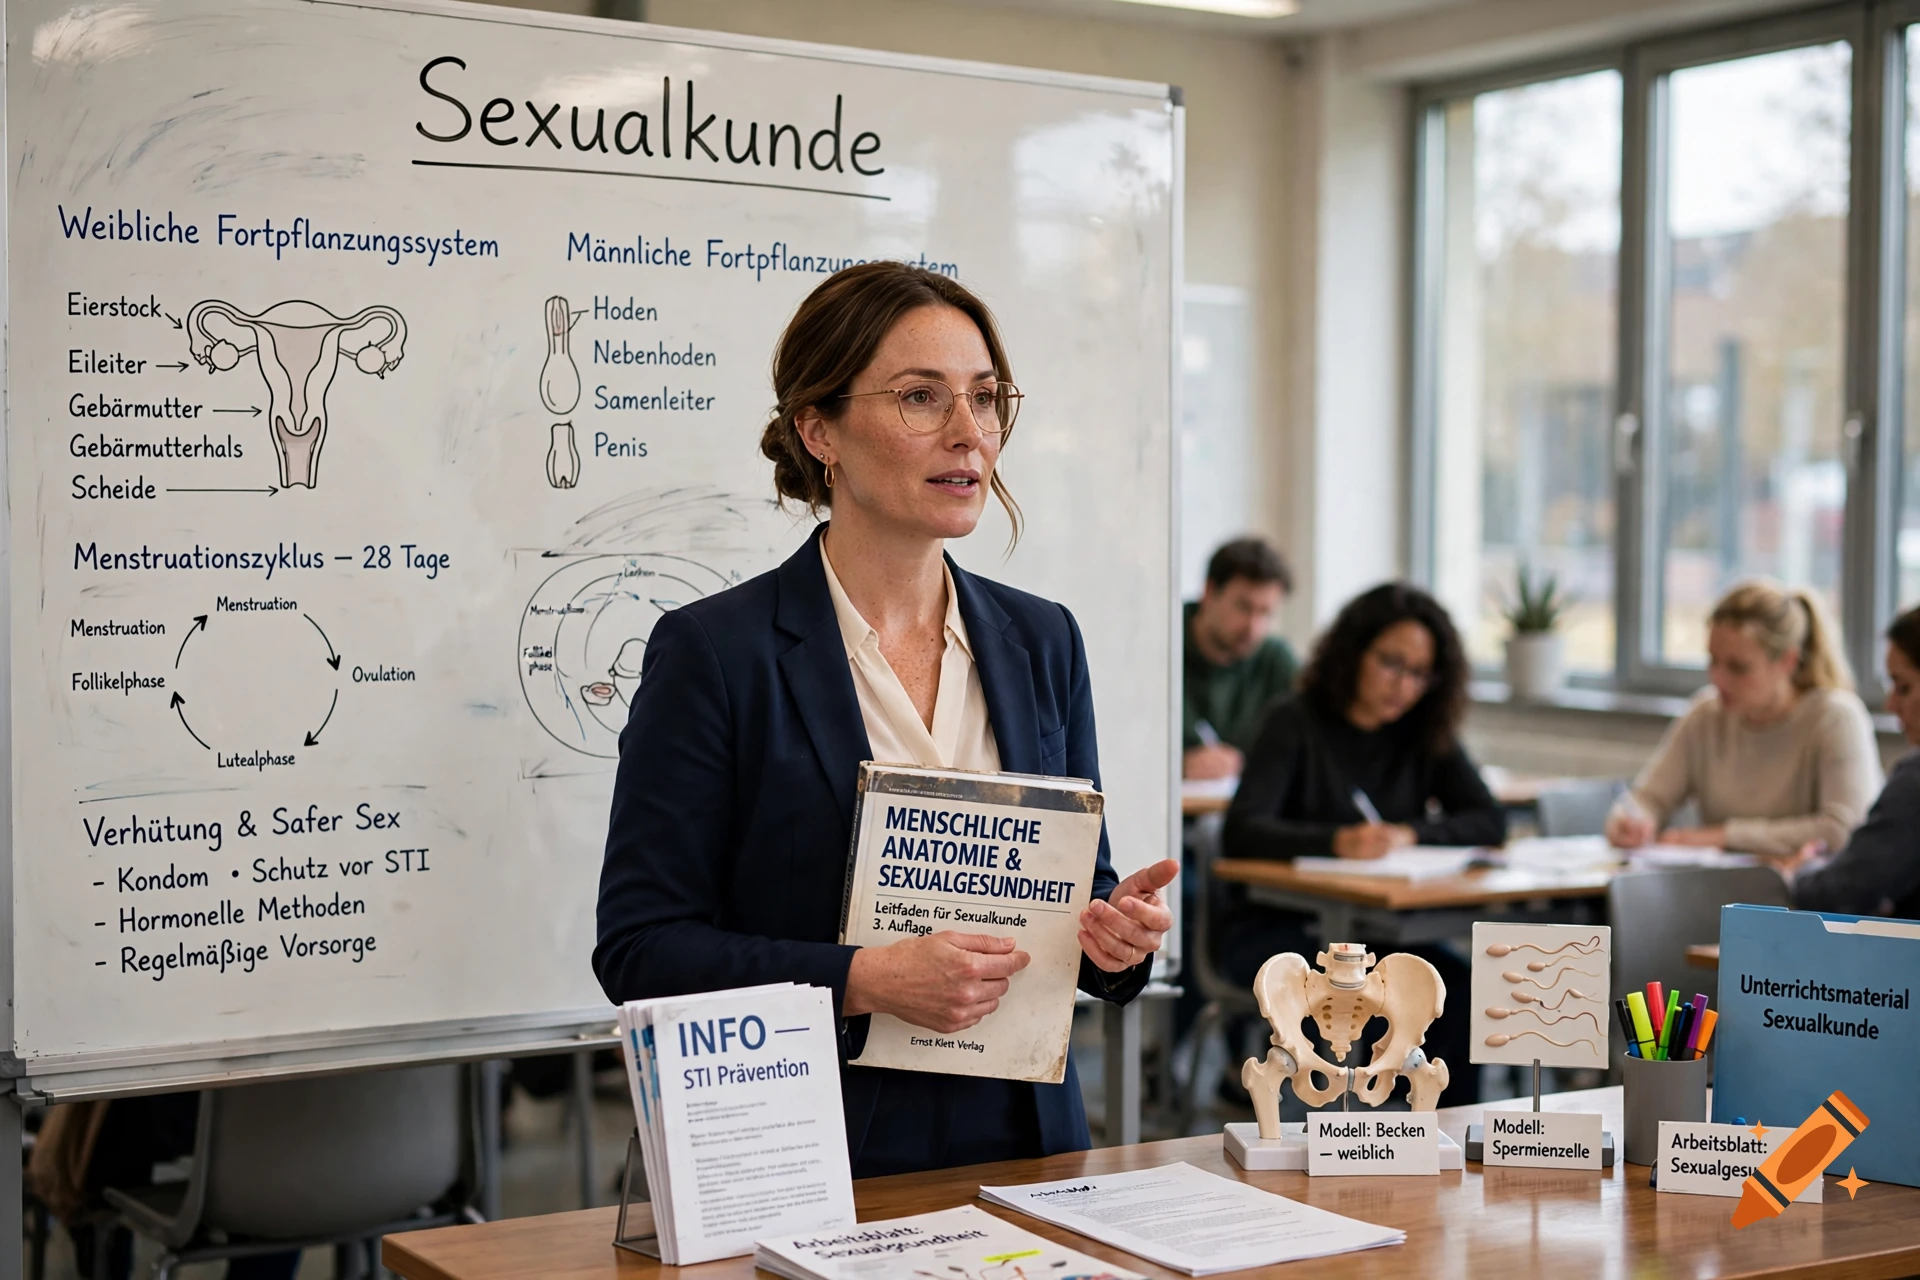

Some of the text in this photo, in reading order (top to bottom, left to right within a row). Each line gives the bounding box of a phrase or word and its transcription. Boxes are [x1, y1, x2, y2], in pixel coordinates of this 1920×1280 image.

[415, 55, 885, 176] Sexualkunde
[57, 204, 499, 265] Weibliche Fortpflanzungssystem
[567, 231, 692, 267] Männliche
[68, 291, 162, 318] Eierstock
[594, 295, 658, 322] Hoden
[68, 349, 148, 375] Eileiter
[594, 339, 716, 367] Nebenhoden
[68, 392, 204, 419] Gebärmutter
[594, 384, 716, 411] Samenleiter
[69, 433, 243, 459] Gebärmutterhals
[594, 431, 648, 458] Penis
[71, 474, 157, 500] Scheide
[73, 541, 324, 581] Menstruationszyklus
[362, 544, 392, 569] 28
[400, 544, 451, 580] Tage
[216, 595, 298, 612] Menstruation
[70, 618, 166, 638] Menstruation
[72, 670, 166, 693] Follikelphase
[352, 664, 416, 683] Ovulation
[217, 749, 296, 773] Lutealphase
[82, 802, 401, 852] Verhütung & Safer Sex
[885, 806, 1042, 844] MENSCHLICHE
[881, 836, 1022, 872] ANATOMIE &
[117, 865, 209, 893] Kondom
[252, 856, 329, 883] Schutz
[339, 860, 374, 877] vor
[385, 848, 430, 874] STI
[878, 864, 1076, 904] SEXUALGESUNDHEIT
[119, 899, 245, 934] Hormonelle
[258, 891, 365, 922] Methoden
[874, 901, 1028, 928] Leitfaden für Sexualkunde
[872, 918, 933, 937] 3. Auflage
[120, 938, 269, 982] Regelmäßige
[279, 932, 377, 964] Vorsorge
[1740, 973, 1910, 1010] Unterrichtsmaterial
[678, 1014, 766, 1058] INFO
[1762, 1007, 1880, 1040] Sexualkunde
[910, 1036, 985, 1054] Ernst Klett Verlag
[683, 1057, 810, 1090] STI Prävention
[1319, 1121, 1425, 1138] Modell: Becken
[1493, 1118, 1545, 1135] Modell:
[1337, 1143, 1395, 1161] weiblich
[1492, 1139, 1590, 1160] Spermienzelle
[1671, 1132, 1768, 1154] Arbeitsblatt:
